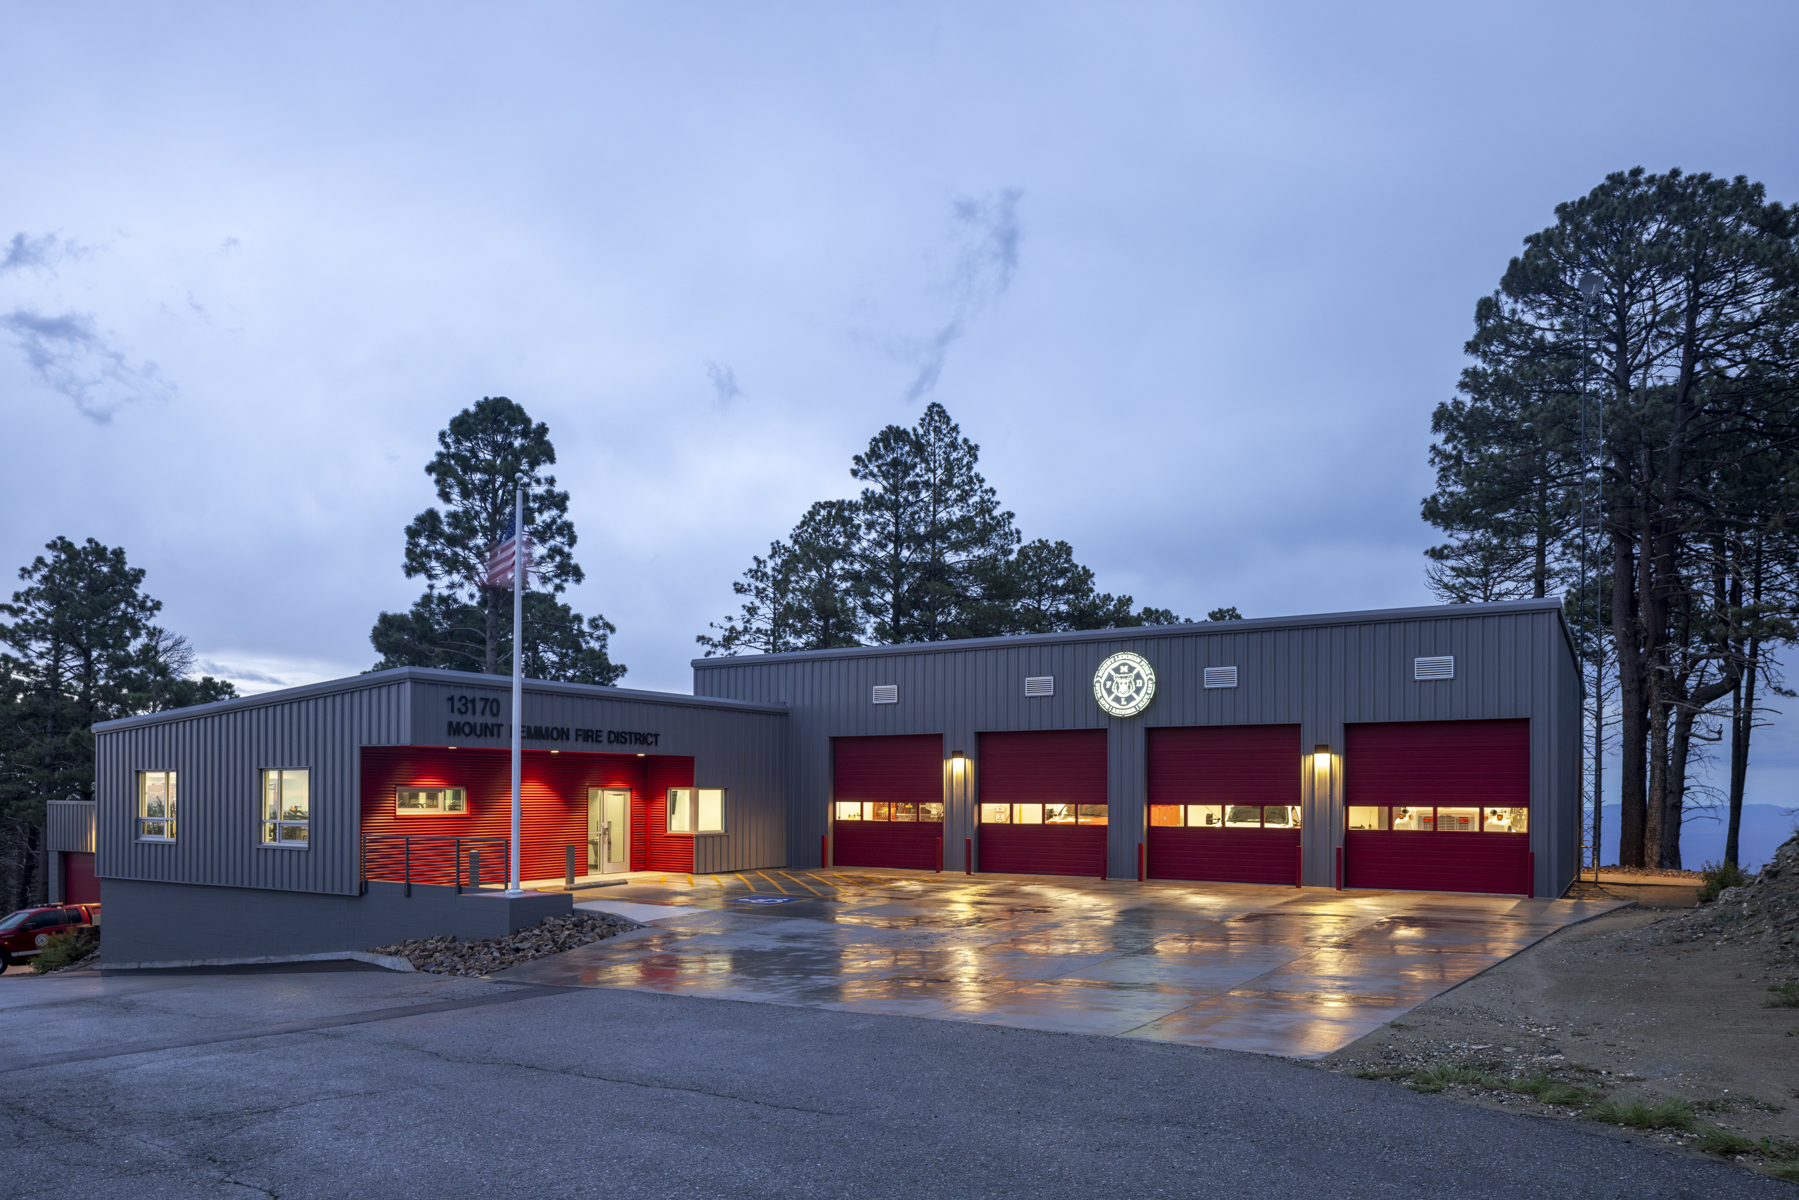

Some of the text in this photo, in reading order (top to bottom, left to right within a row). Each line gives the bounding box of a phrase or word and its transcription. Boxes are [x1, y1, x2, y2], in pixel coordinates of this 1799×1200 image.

[1120, 665, 1128, 673] M
[447, 695, 501, 717] 13170
[1121, 697, 1127, 705] L
[447, 721, 504, 738] MOUNT
[575, 728, 603, 743] FIRE
[607, 730, 661, 746] DISTRICT
